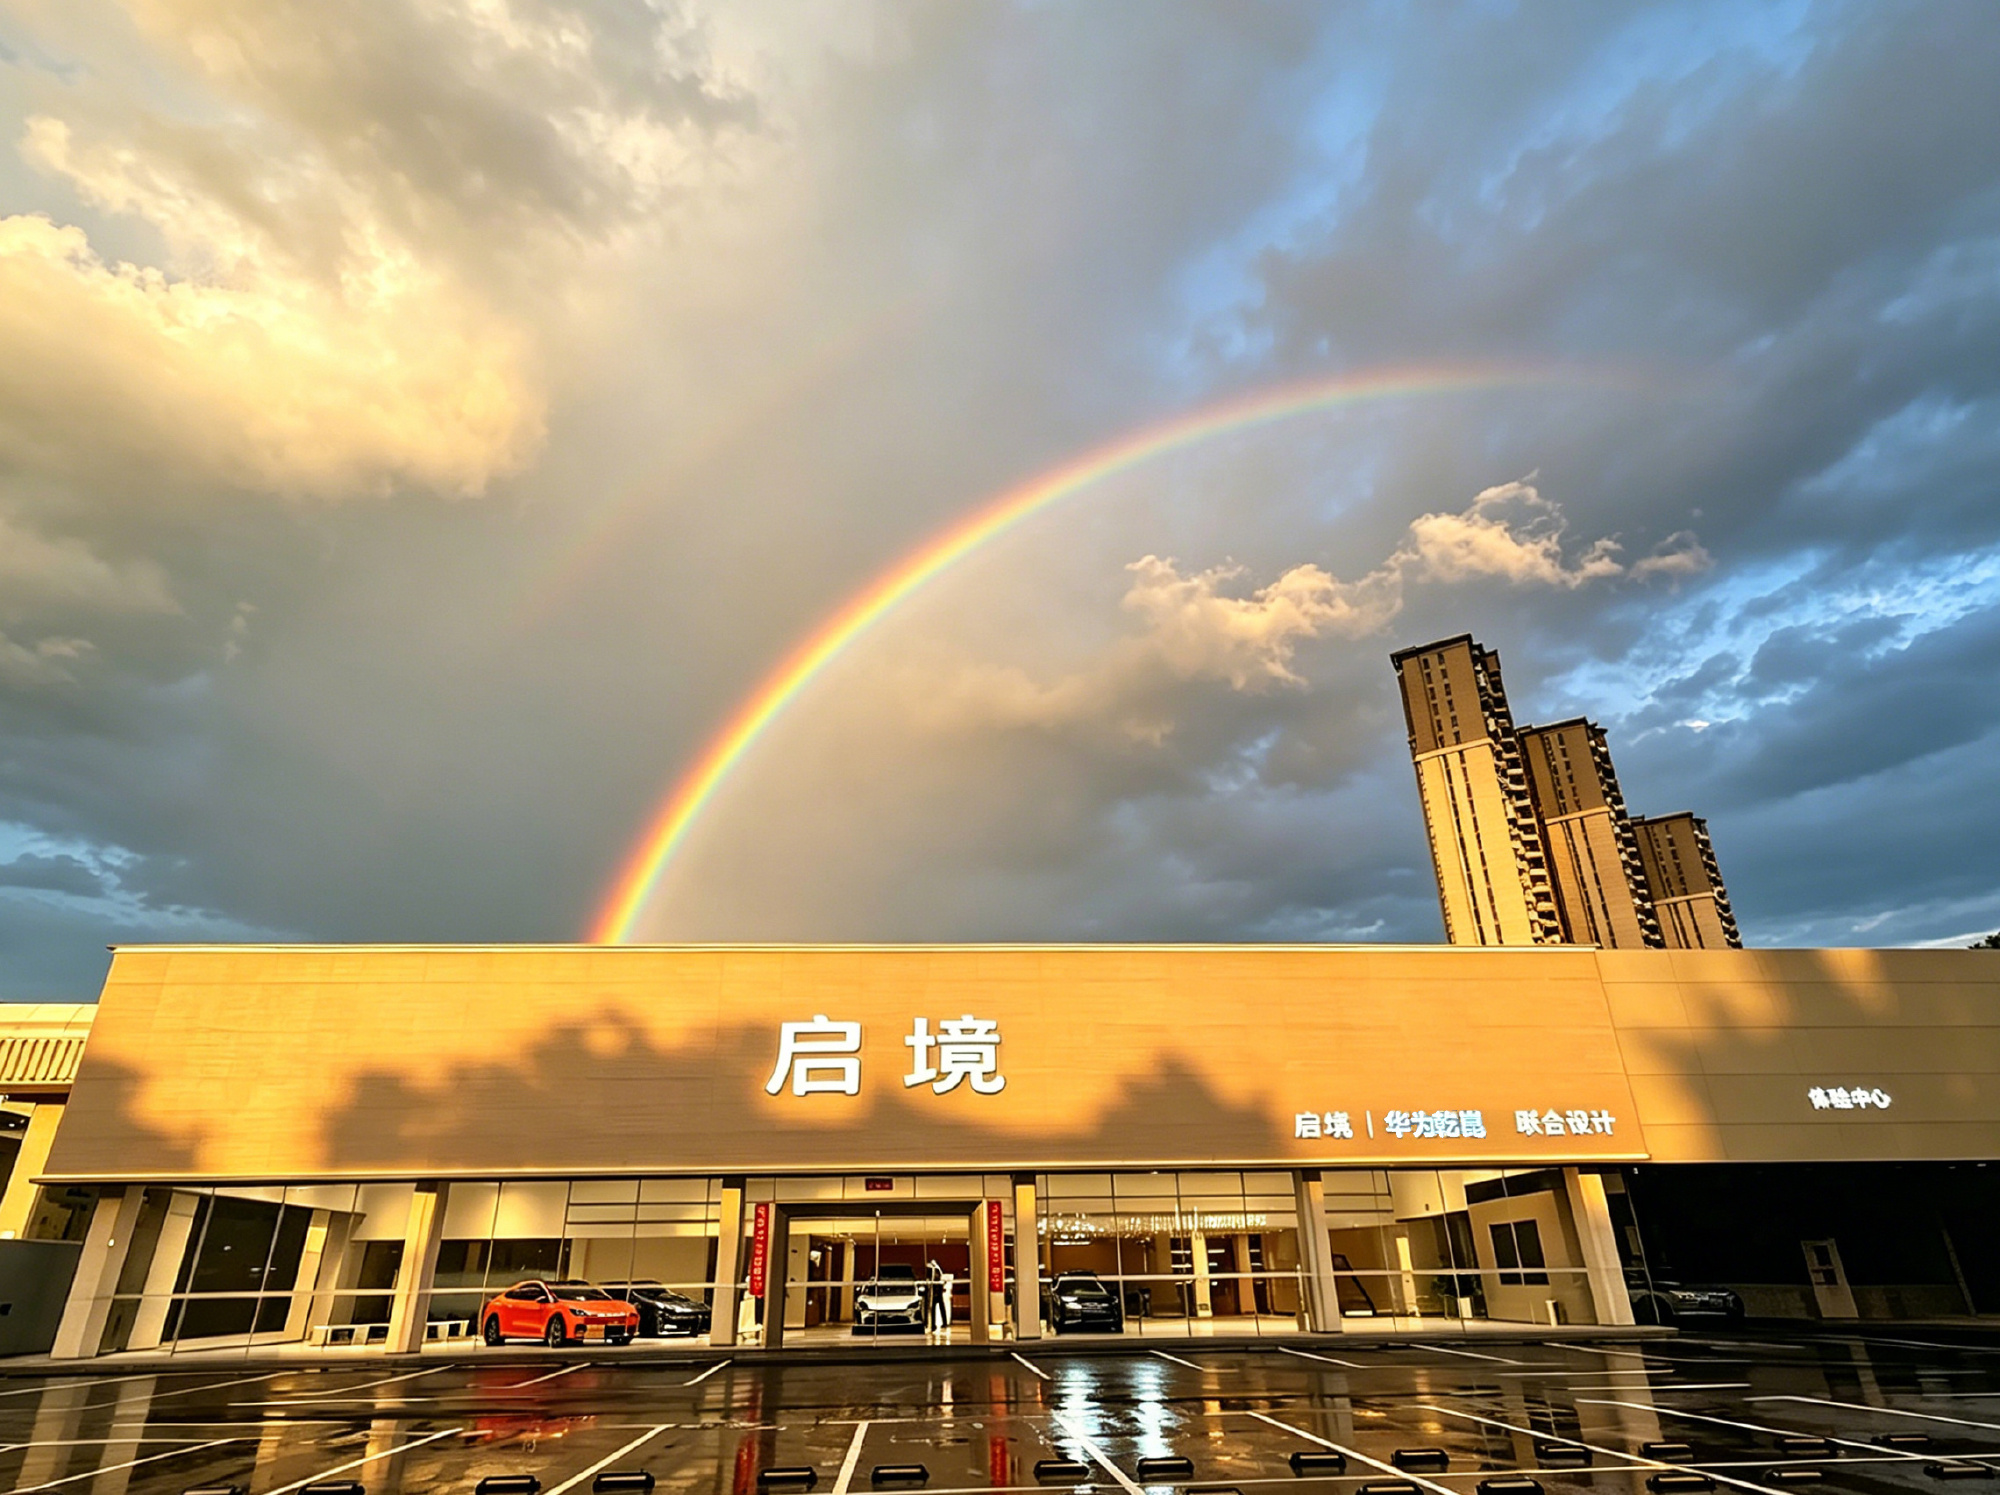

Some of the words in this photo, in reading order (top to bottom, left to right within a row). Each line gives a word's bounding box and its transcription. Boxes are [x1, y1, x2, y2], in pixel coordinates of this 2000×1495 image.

[765, 1014, 1006, 1096] 启境
[1295, 1111, 1354, 1139] 启境
[1515, 1108, 1616, 1136] 联合设计
